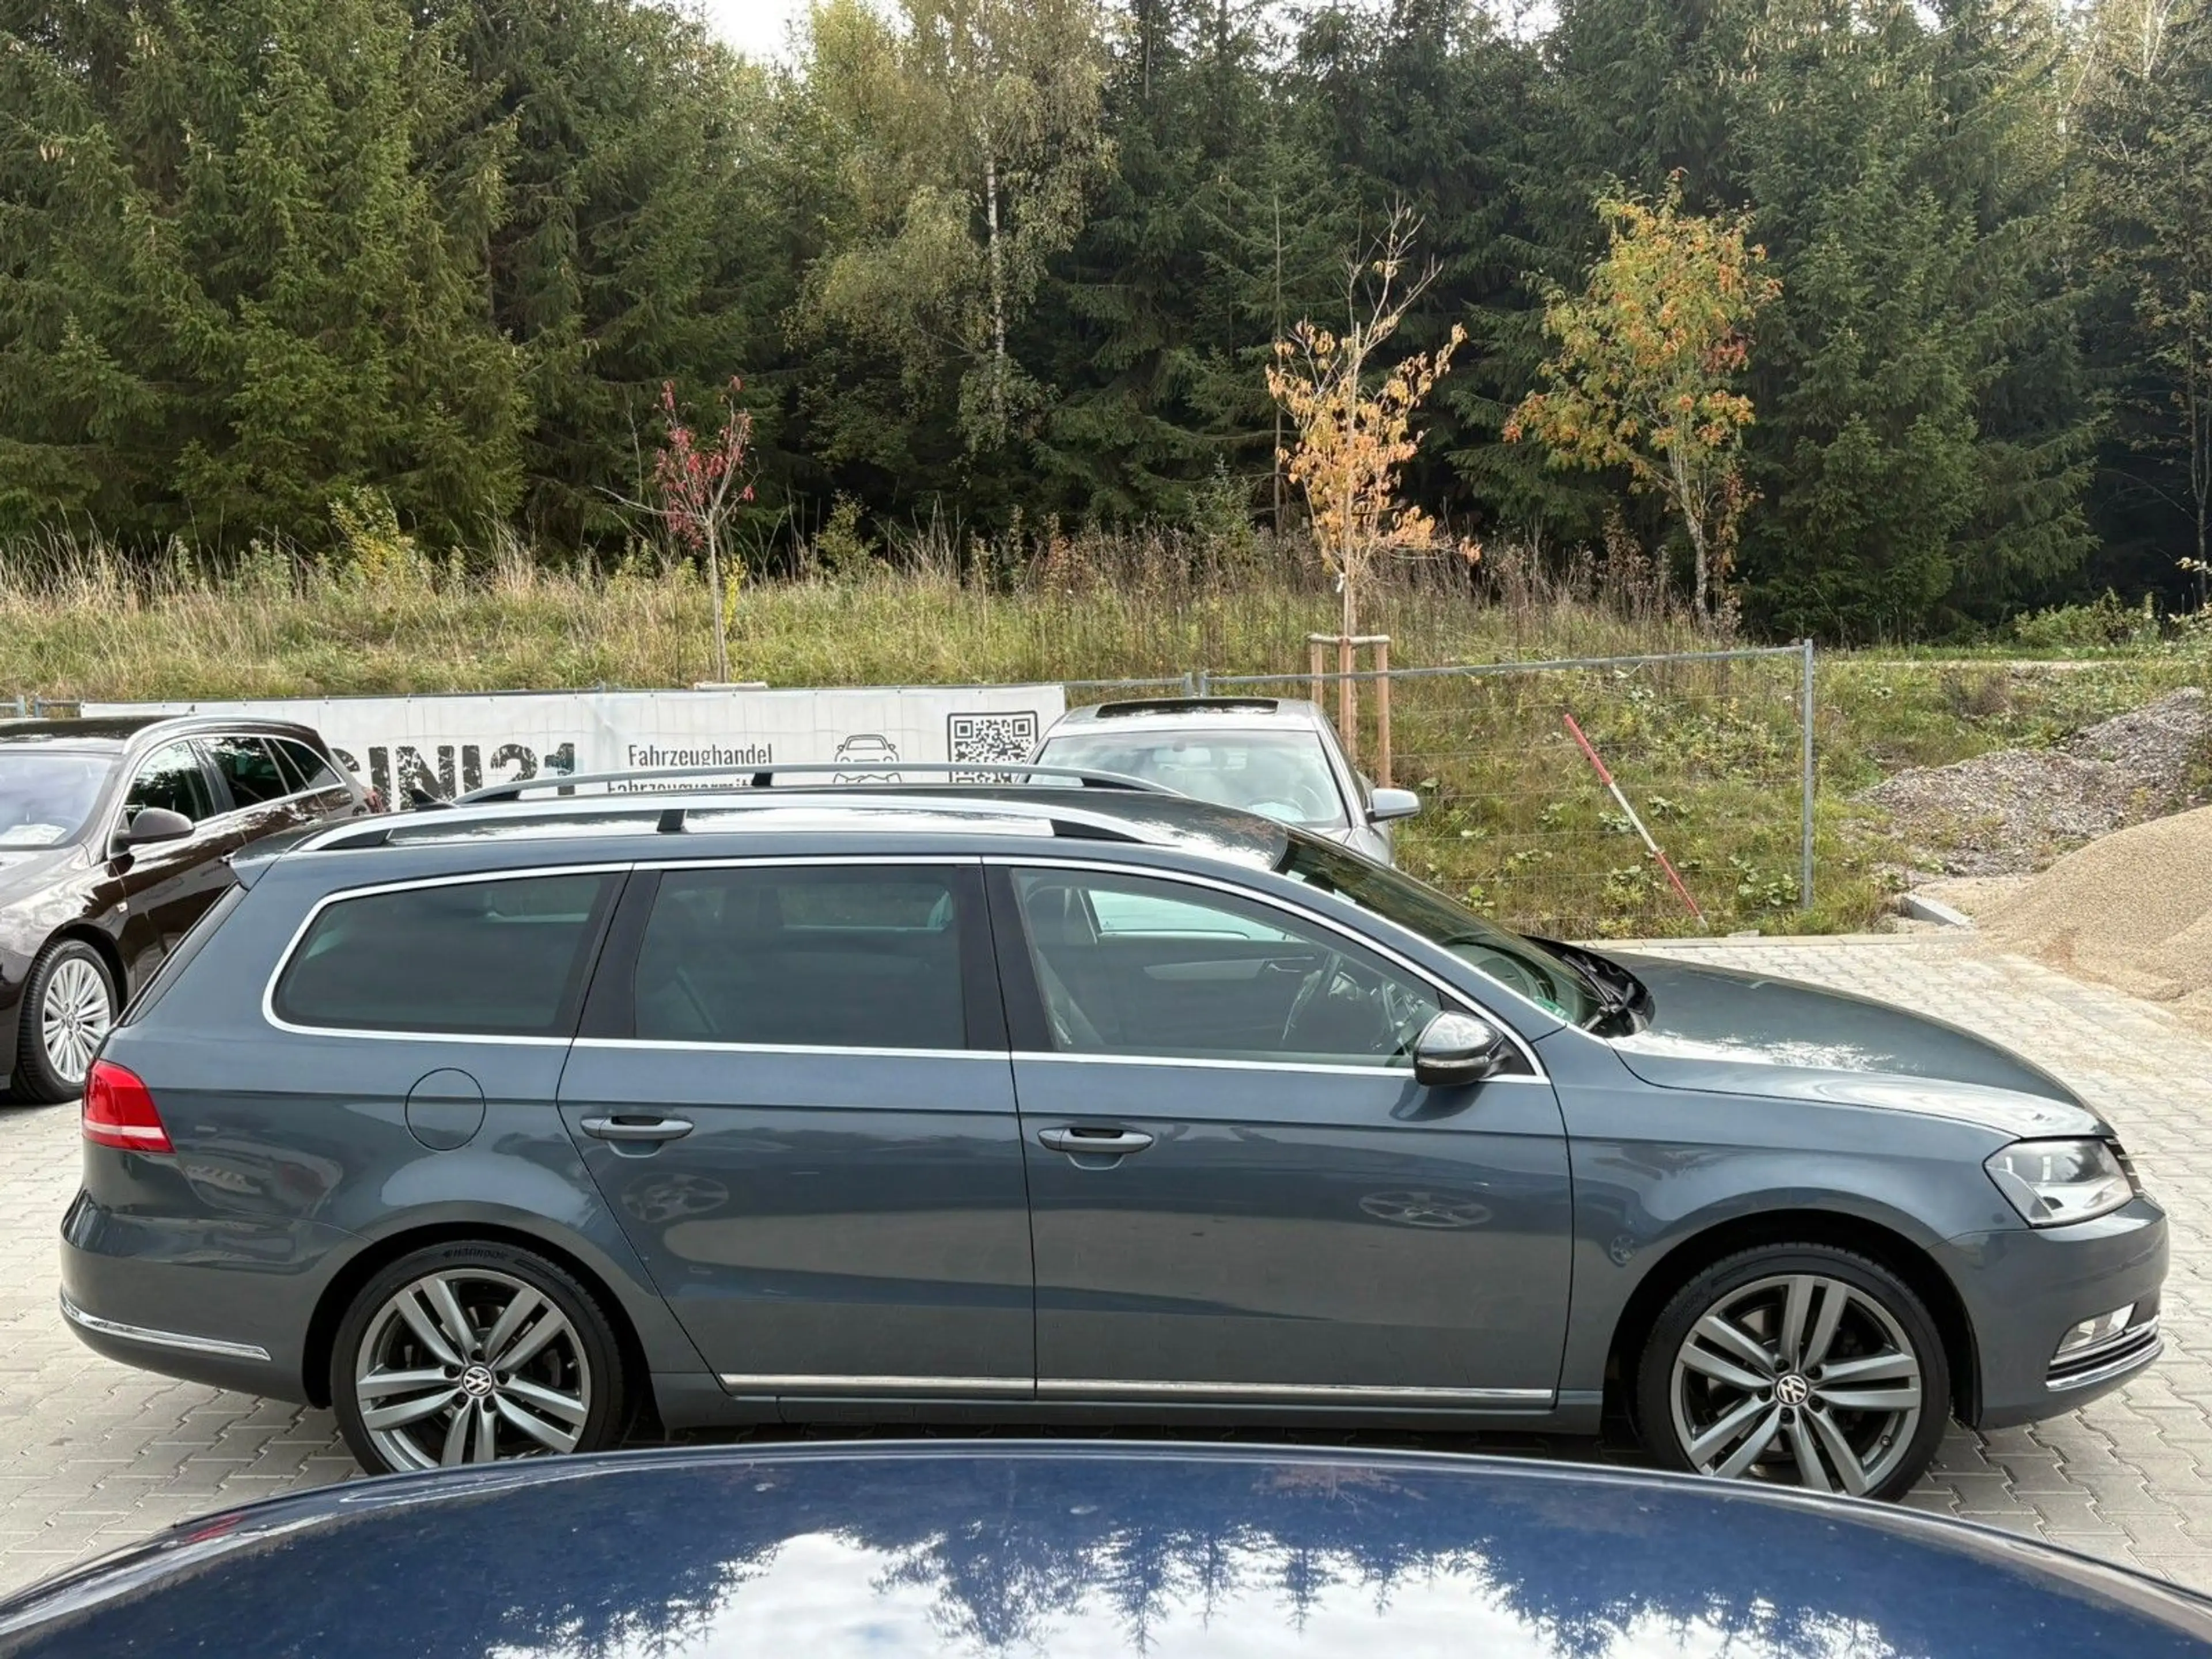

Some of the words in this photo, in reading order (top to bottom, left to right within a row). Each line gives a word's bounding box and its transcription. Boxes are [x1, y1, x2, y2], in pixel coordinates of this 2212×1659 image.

[628, 743, 772, 767] Fahrzeughandel
[463, 1366, 491, 1395] VW
[1777, 1374, 1806, 1404] VW
